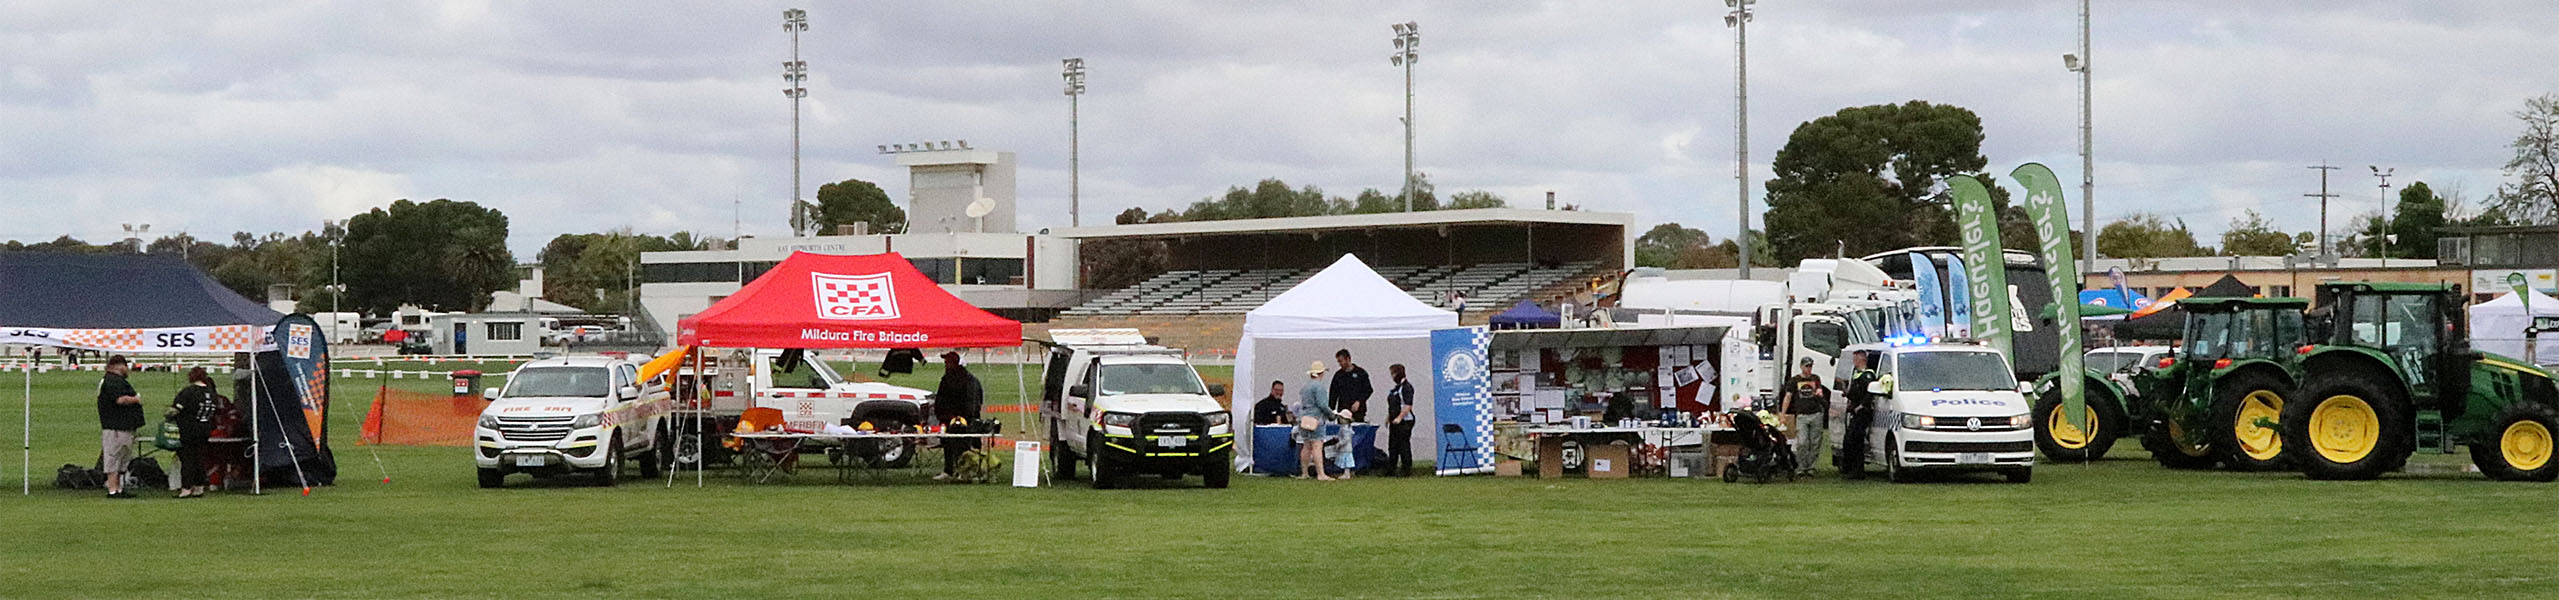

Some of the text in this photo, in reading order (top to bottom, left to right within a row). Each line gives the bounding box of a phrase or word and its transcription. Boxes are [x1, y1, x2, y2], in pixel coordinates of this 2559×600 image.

[830, 305, 885, 316] CFA
[156, 332, 196, 348] SES
[290, 336, 310, 345] SES
[801, 329, 929, 343] Mildura Fire Brigade
[1931, 398, 2006, 407] Police
